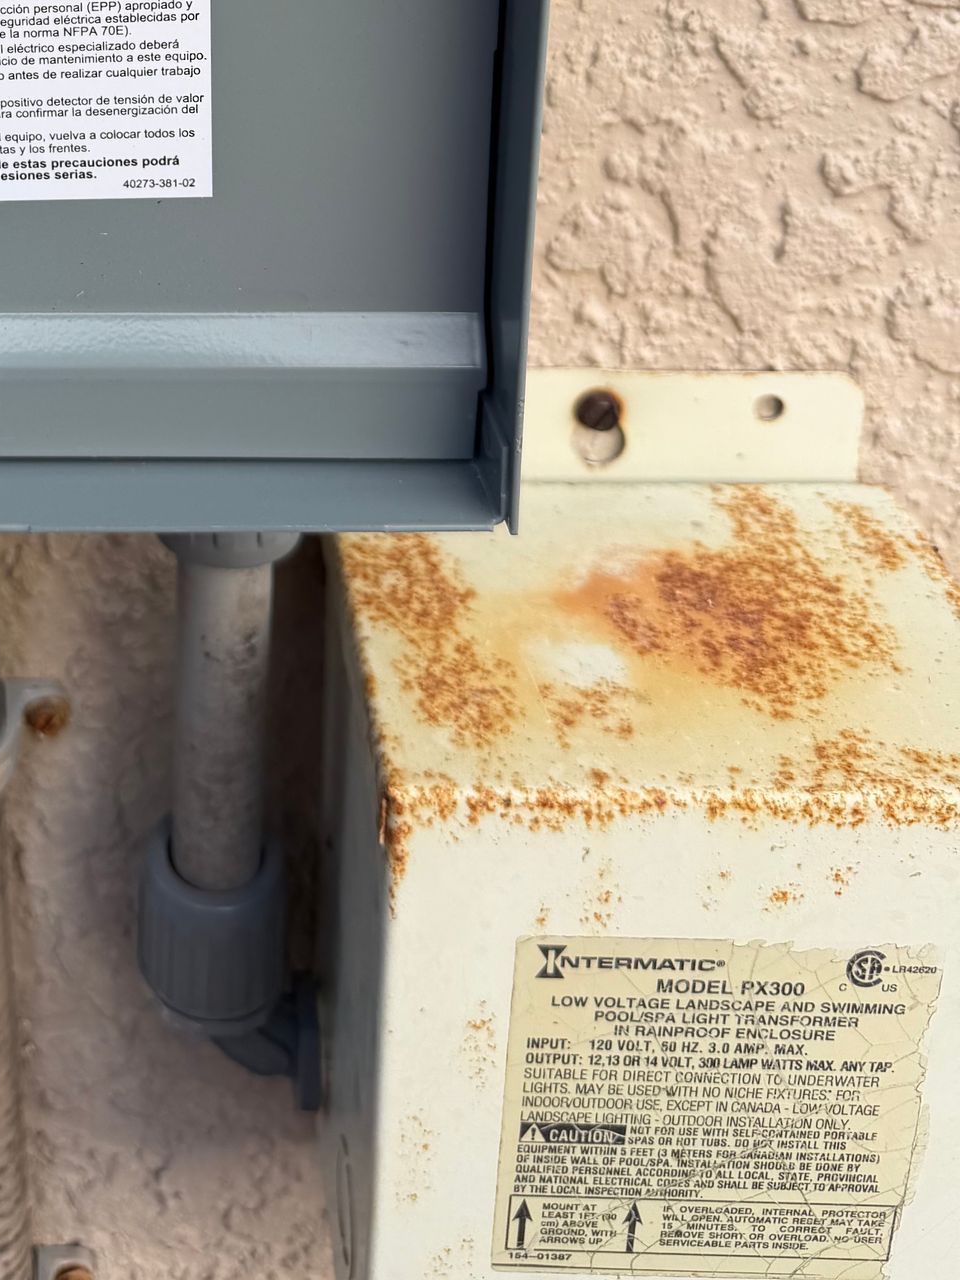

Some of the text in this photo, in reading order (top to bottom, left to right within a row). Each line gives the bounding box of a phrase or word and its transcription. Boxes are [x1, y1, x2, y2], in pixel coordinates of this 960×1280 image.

[122, 177, 195, 188] 40273-381-02
[656, 978, 804, 996] MODEL PX300
[882, 984, 897, 992] US
[551, 995, 905, 1014] LOW VOLTAGE LANDSCAPE AND SWIMMING
[594, 1010, 858, 1027] POOL/SPA LIGHT TRANSFORMER
[614, 1024, 835, 1041] IN RAINPROOF ENCLOSURE
[526, 1037, 570, 1049] INPUT:
[589, 1039, 612, 1050] 120
[617, 1039, 657, 1054] VOLT,
[681, 1041, 702, 1053] HZ.
[708, 1041, 729, 1053] 3.0
[733, 1042, 770, 1054] AMP.
[773, 1043, 807, 1055] MAX.
[549, 1129, 614, 1144] CAUTION
